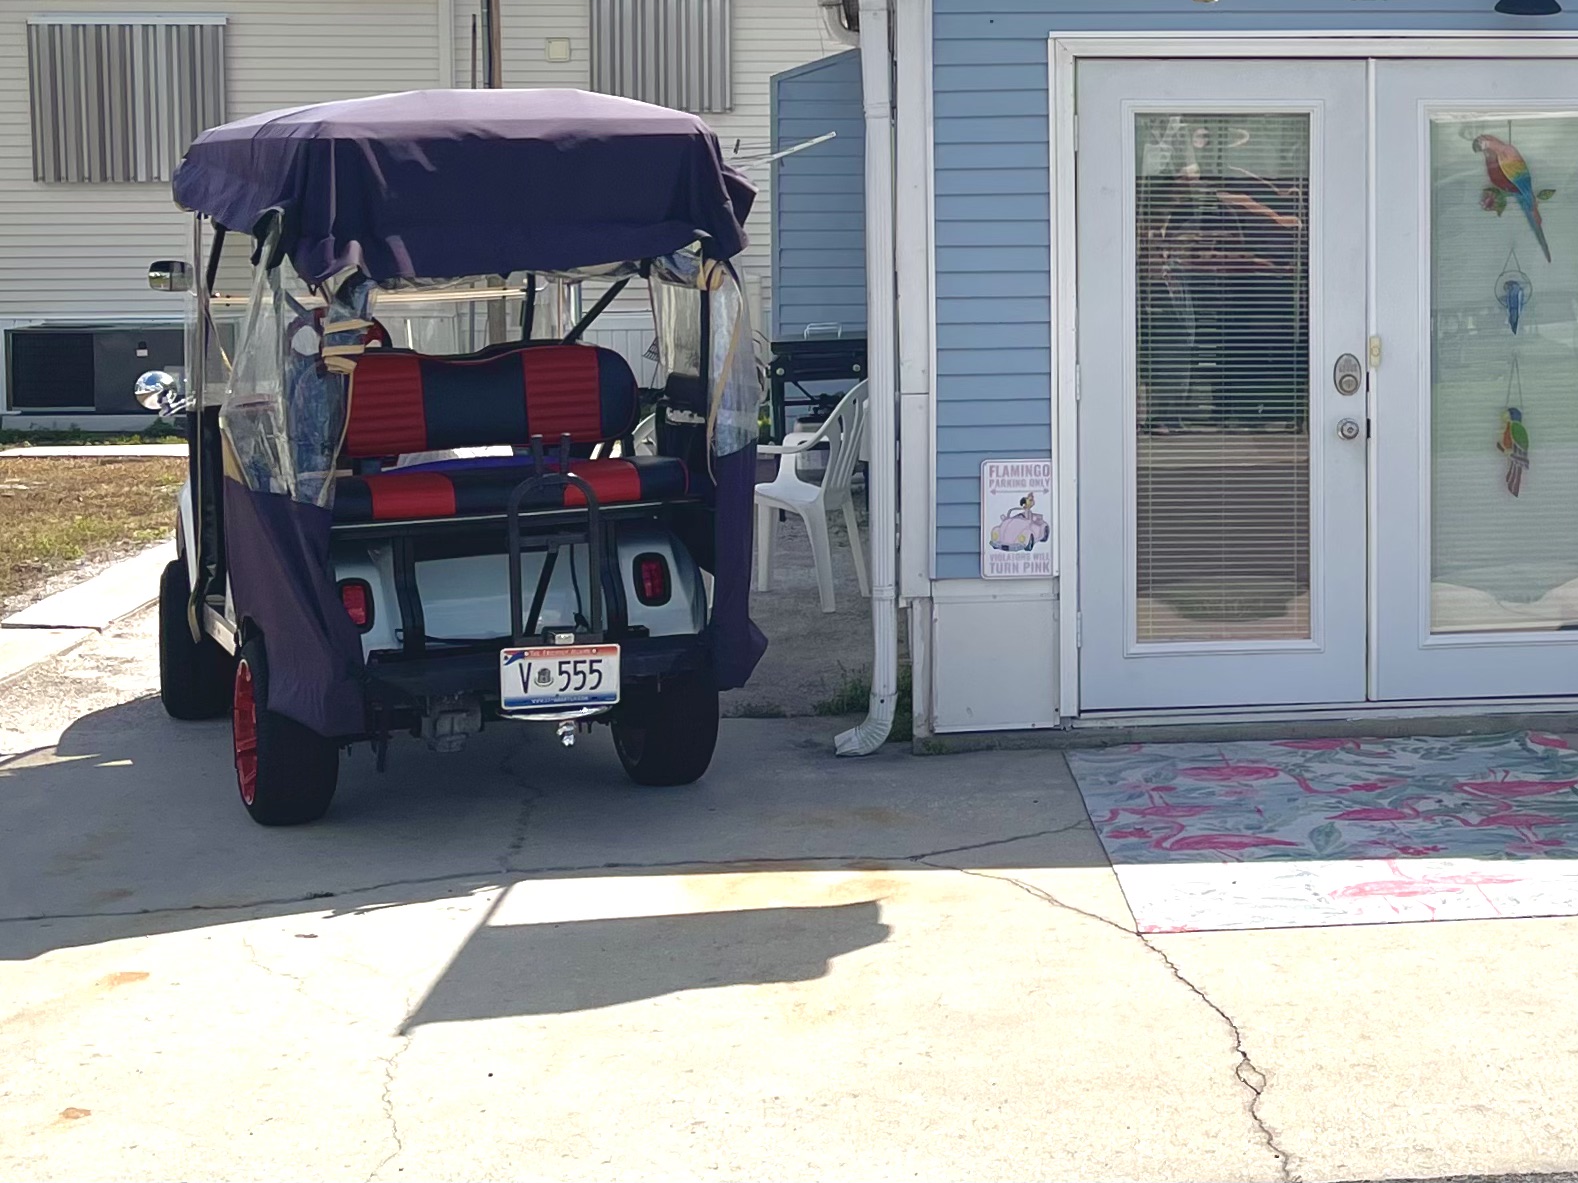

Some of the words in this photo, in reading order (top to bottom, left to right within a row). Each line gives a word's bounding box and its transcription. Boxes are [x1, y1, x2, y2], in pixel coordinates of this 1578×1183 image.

[989, 464, 1051, 478] FLAMINGO
[989, 478, 1027, 488] PARKING
[1029, 477, 1051, 488] ONLY
[1033, 552, 1050, 561] WILL
[989, 562, 1019, 574] TURN
[1023, 561, 1050, 574] PINK
[518, 662, 532, 694] V
[558, 659, 603, 692] 555
